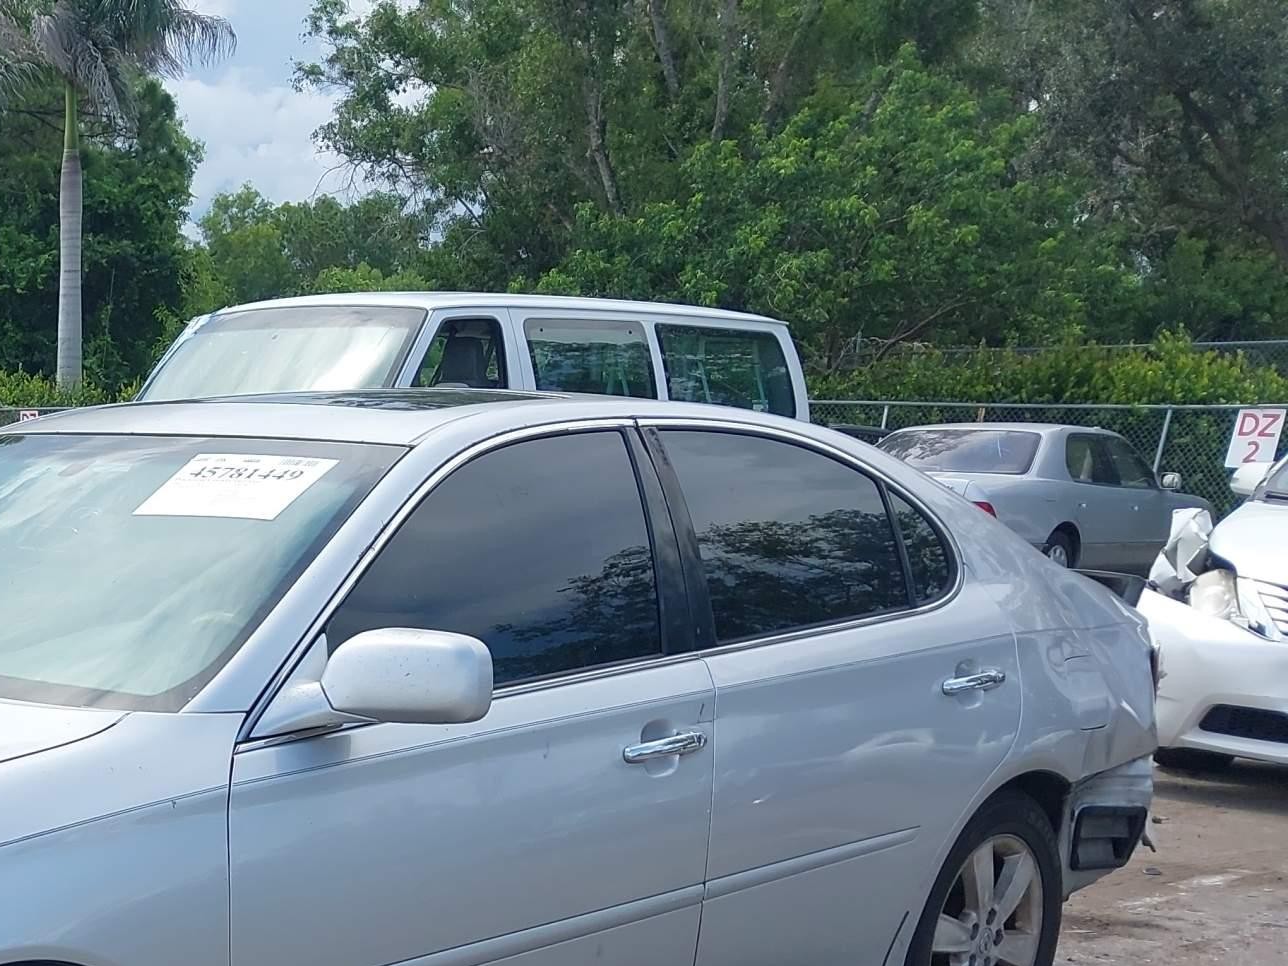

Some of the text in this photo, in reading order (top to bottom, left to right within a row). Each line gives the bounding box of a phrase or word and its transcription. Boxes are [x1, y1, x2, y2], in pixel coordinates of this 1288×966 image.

[1238, 413, 1281, 437] DZ
[1242, 441, 1260, 463] 2
[190, 466, 304, 480] 45781449
